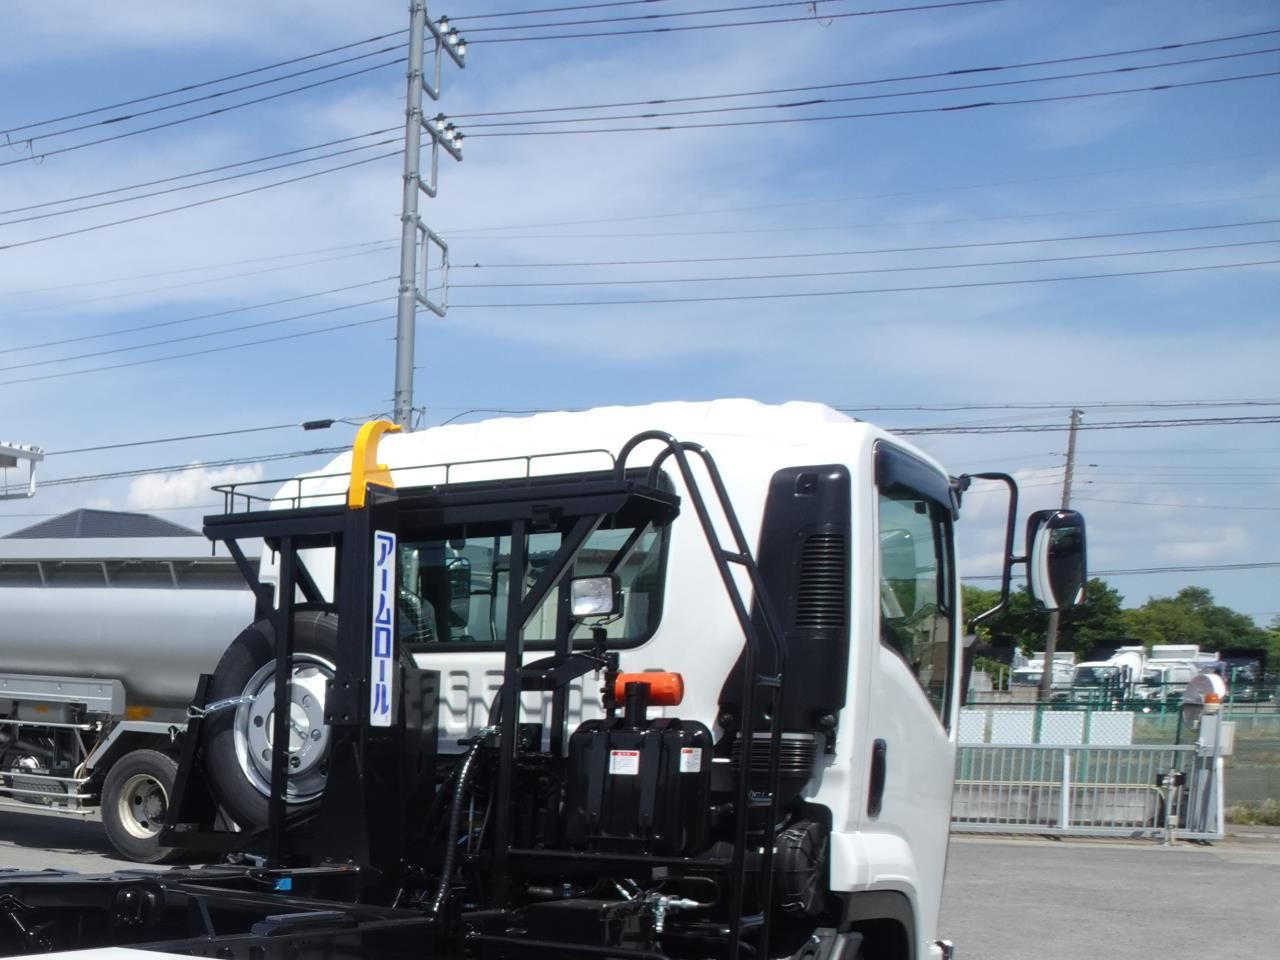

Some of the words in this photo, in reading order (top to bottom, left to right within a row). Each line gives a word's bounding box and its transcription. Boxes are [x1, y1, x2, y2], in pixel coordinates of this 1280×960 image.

[373, 533, 394, 715] アームロール
